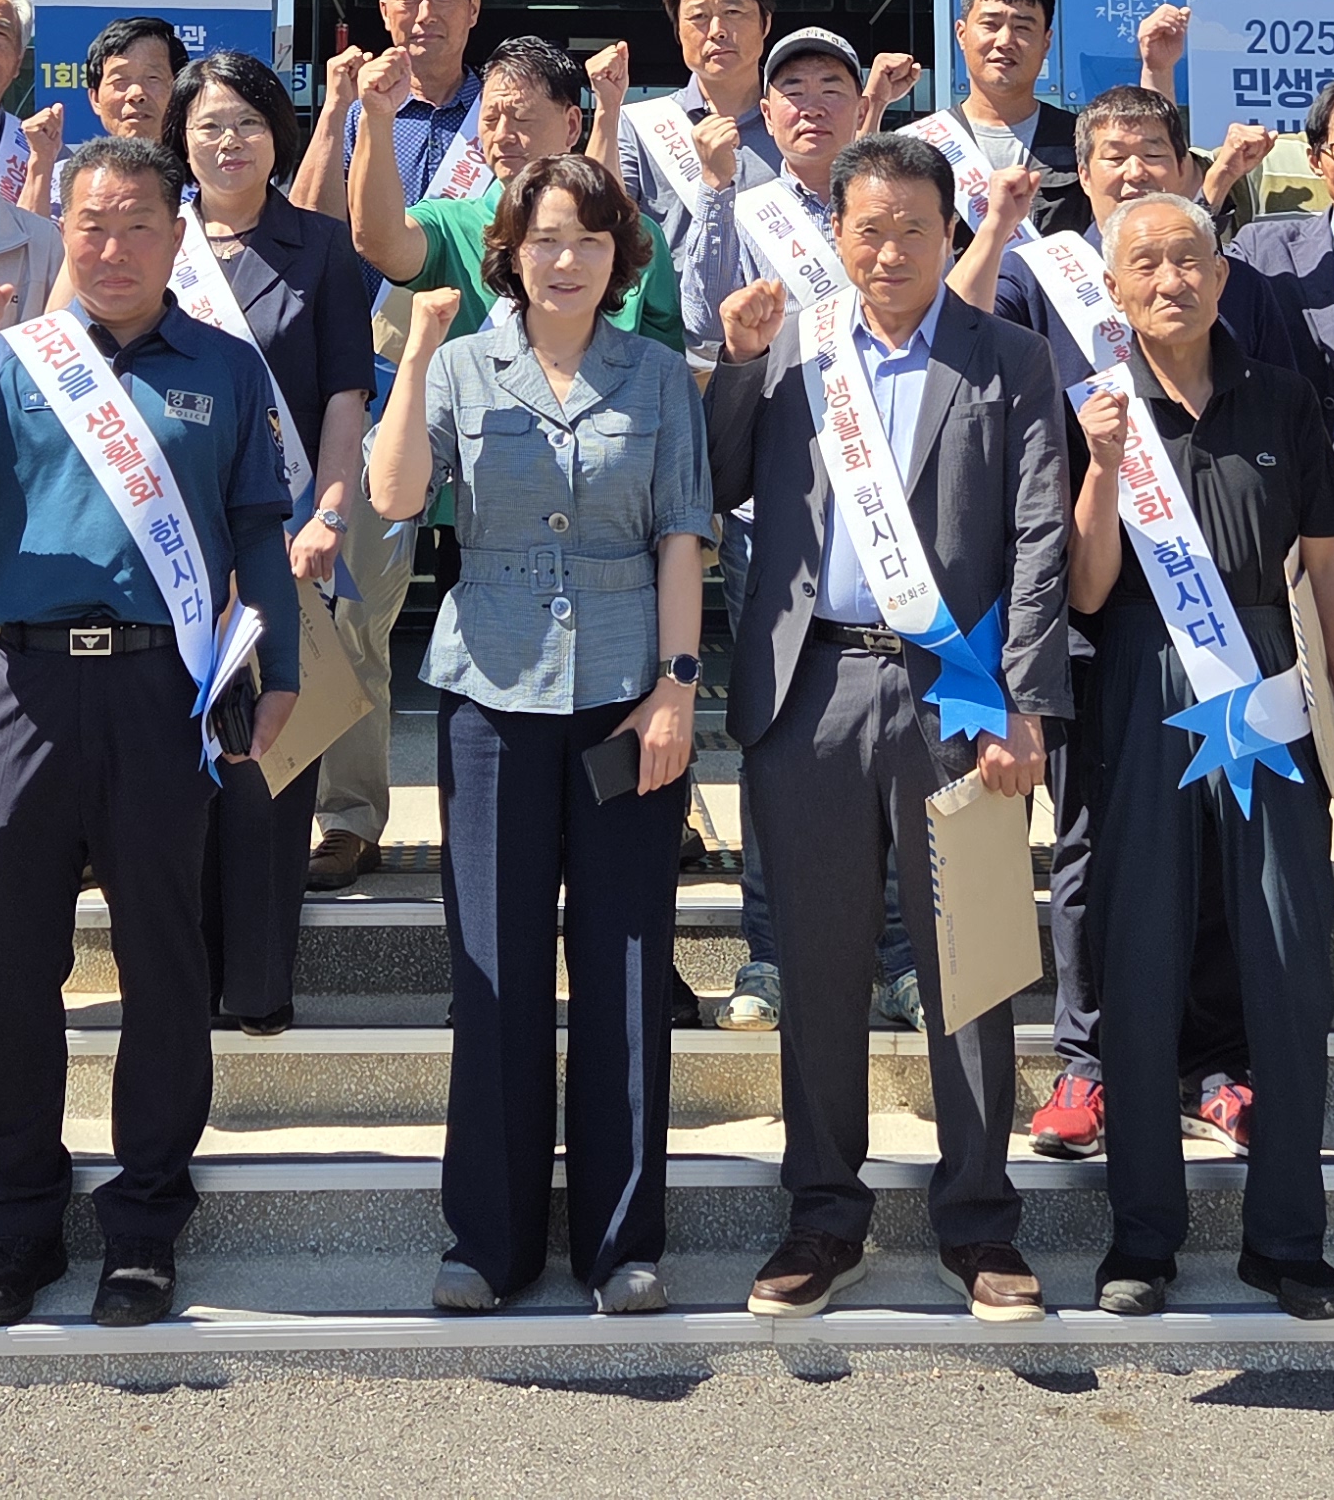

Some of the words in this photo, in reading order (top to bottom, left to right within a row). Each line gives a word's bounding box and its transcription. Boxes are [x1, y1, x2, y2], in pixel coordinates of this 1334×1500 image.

[653, 118, 703, 183] 안전을
[756, 200, 796, 240] 매월
[791, 239, 807, 259] 4
[1046, 244, 1104, 307] 안전을
[813, 299, 838, 372] 안전을
[824, 376, 873, 473] 생활화
[21, 318, 99, 401] 안전을
[84, 400, 165, 507] 생활화
[148, 513, 205, 636] 합시다
[853, 484, 910, 581] 합시다
[896, 581, 930, 607] 강화군
[1152, 535, 1227, 650] 합시다
